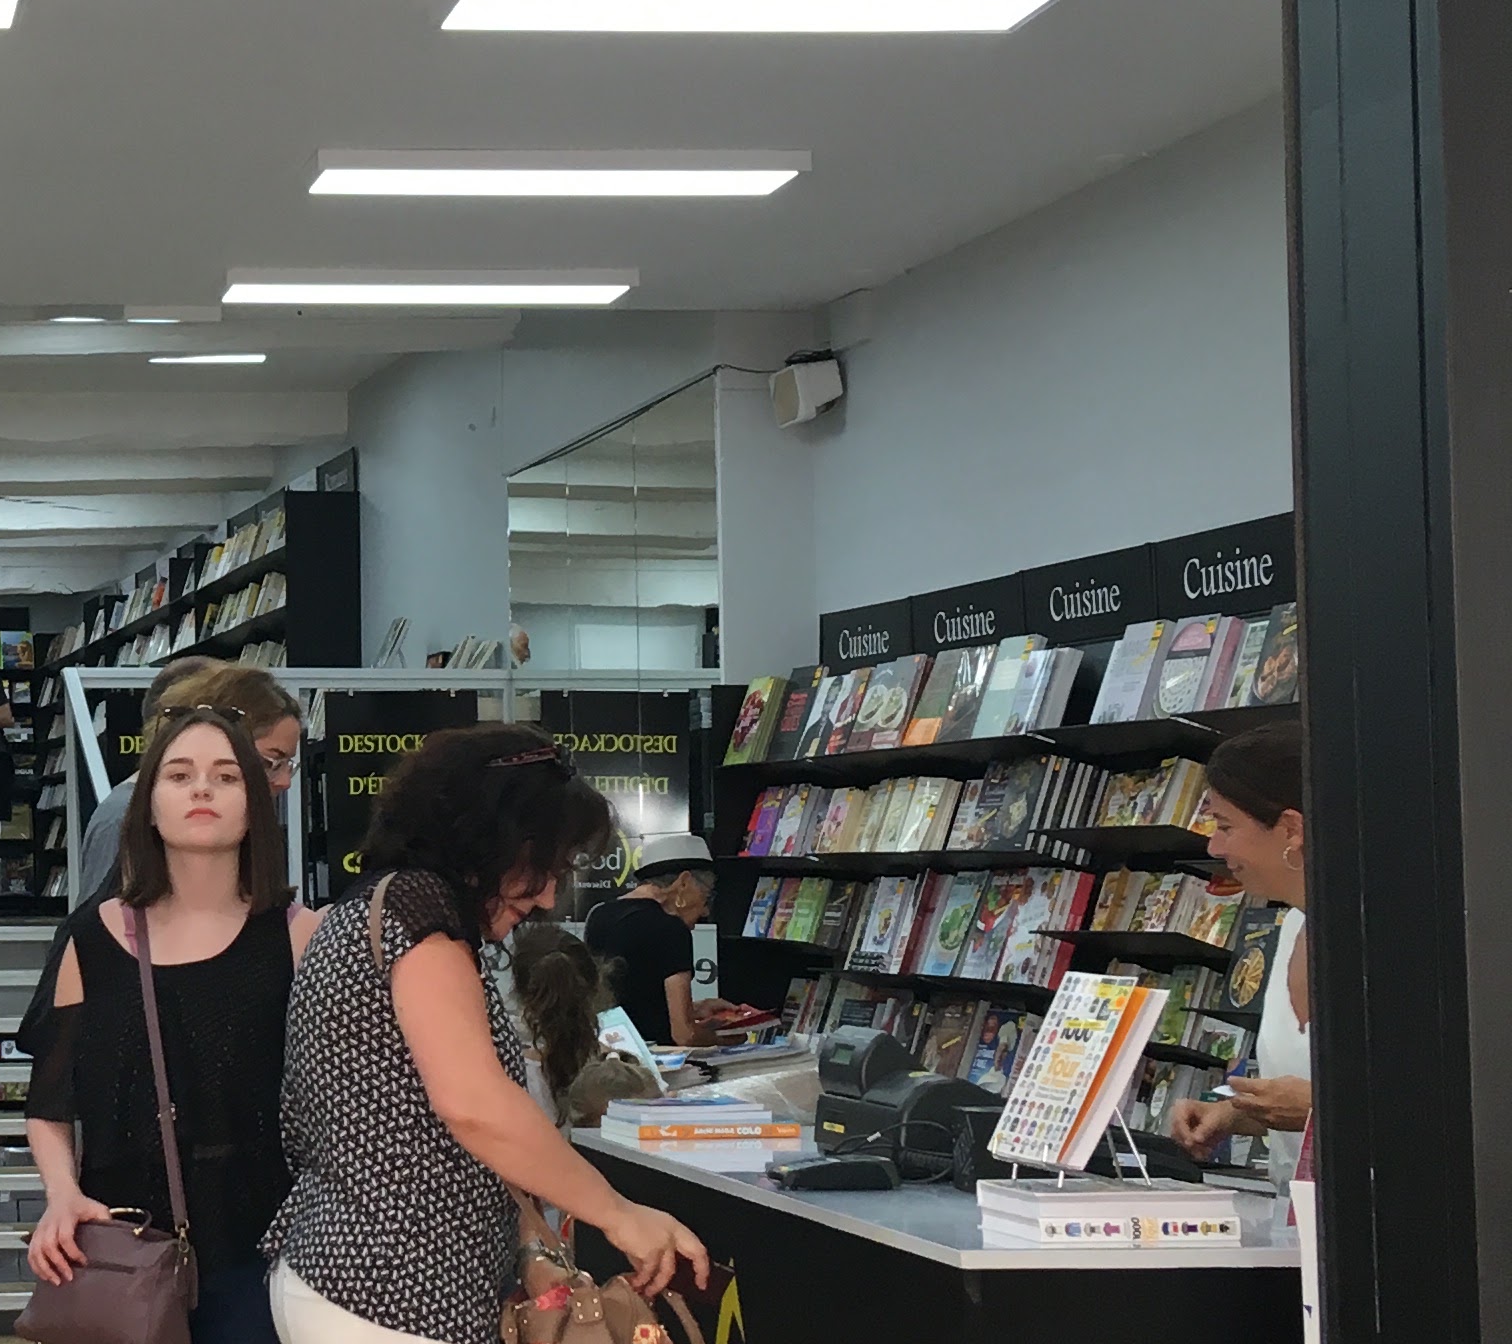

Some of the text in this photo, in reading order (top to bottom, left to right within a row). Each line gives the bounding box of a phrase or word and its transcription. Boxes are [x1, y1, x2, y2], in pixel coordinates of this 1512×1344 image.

[1183, 548, 1275, 600] Cuisine
[1049, 579, 1122, 623] Cuisine
[838, 626, 890, 660] Cuisine
[933, 604, 997, 644] Cuisine
